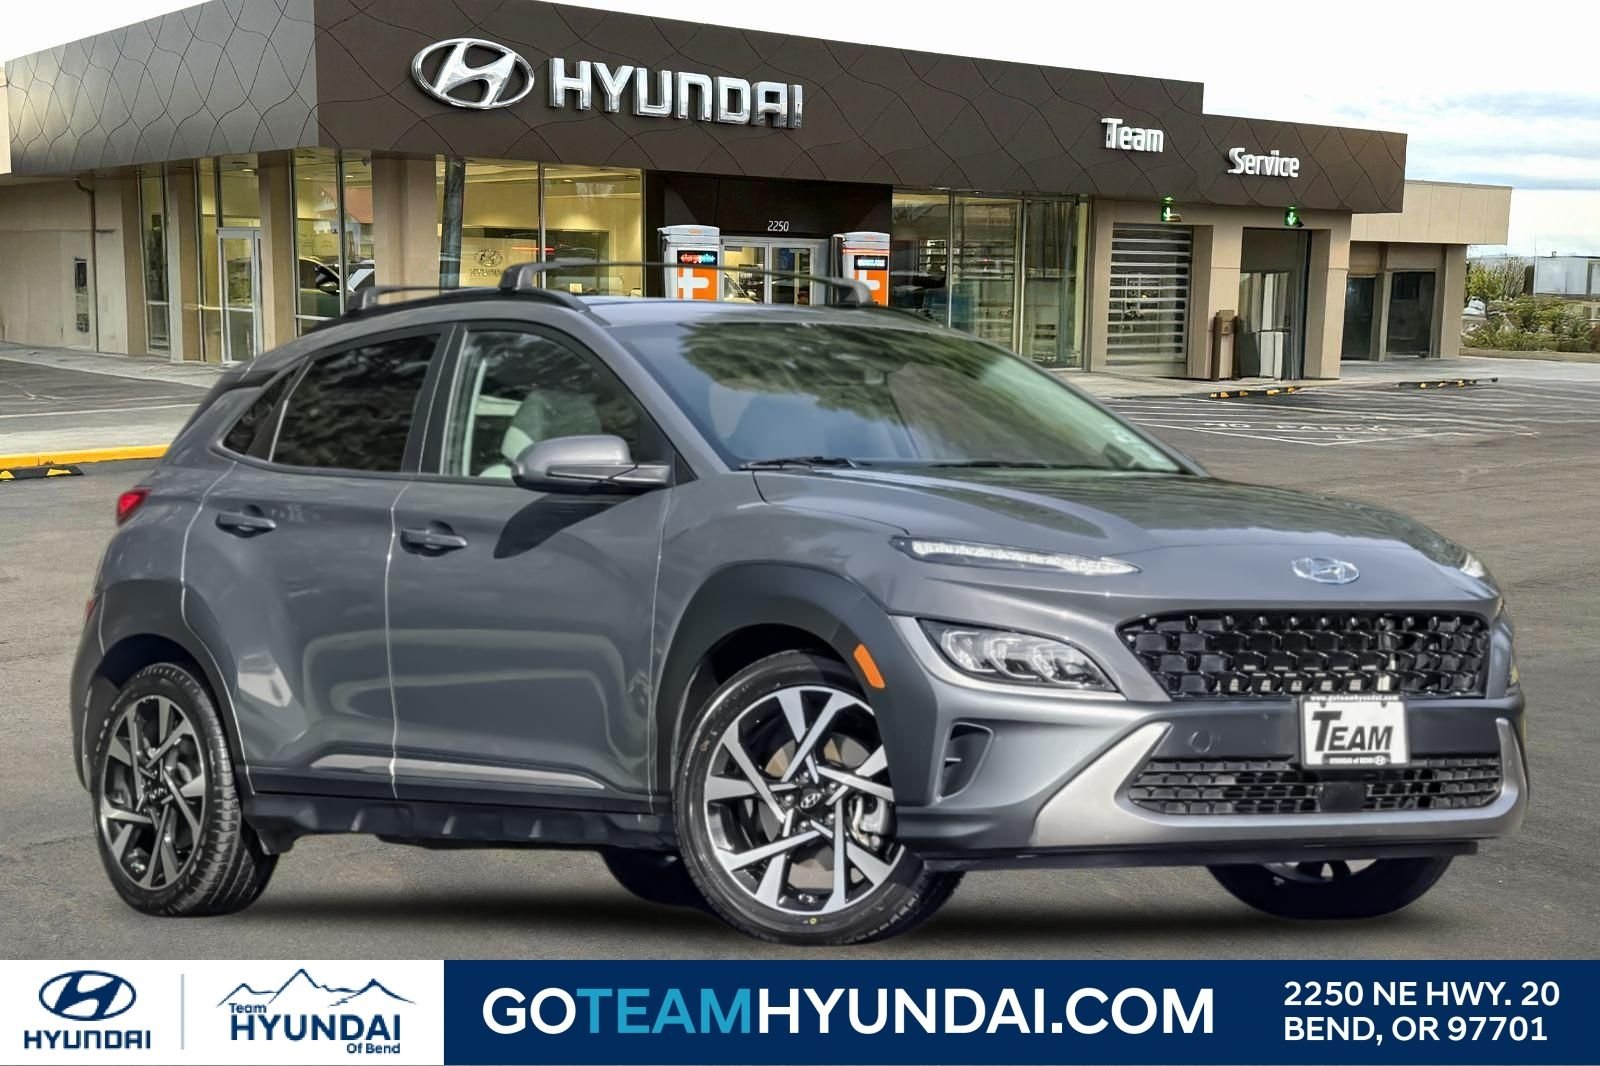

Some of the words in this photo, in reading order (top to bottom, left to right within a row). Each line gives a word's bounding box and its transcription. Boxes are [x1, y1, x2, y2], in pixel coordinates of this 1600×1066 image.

[549, 57, 803, 129] HYUNDAI
[1101, 117, 1164, 153] Team
[1227, 147, 1300, 178] Service
[767, 220, 790, 232] 2250
[1311, 710, 1394, 752] TEAM
